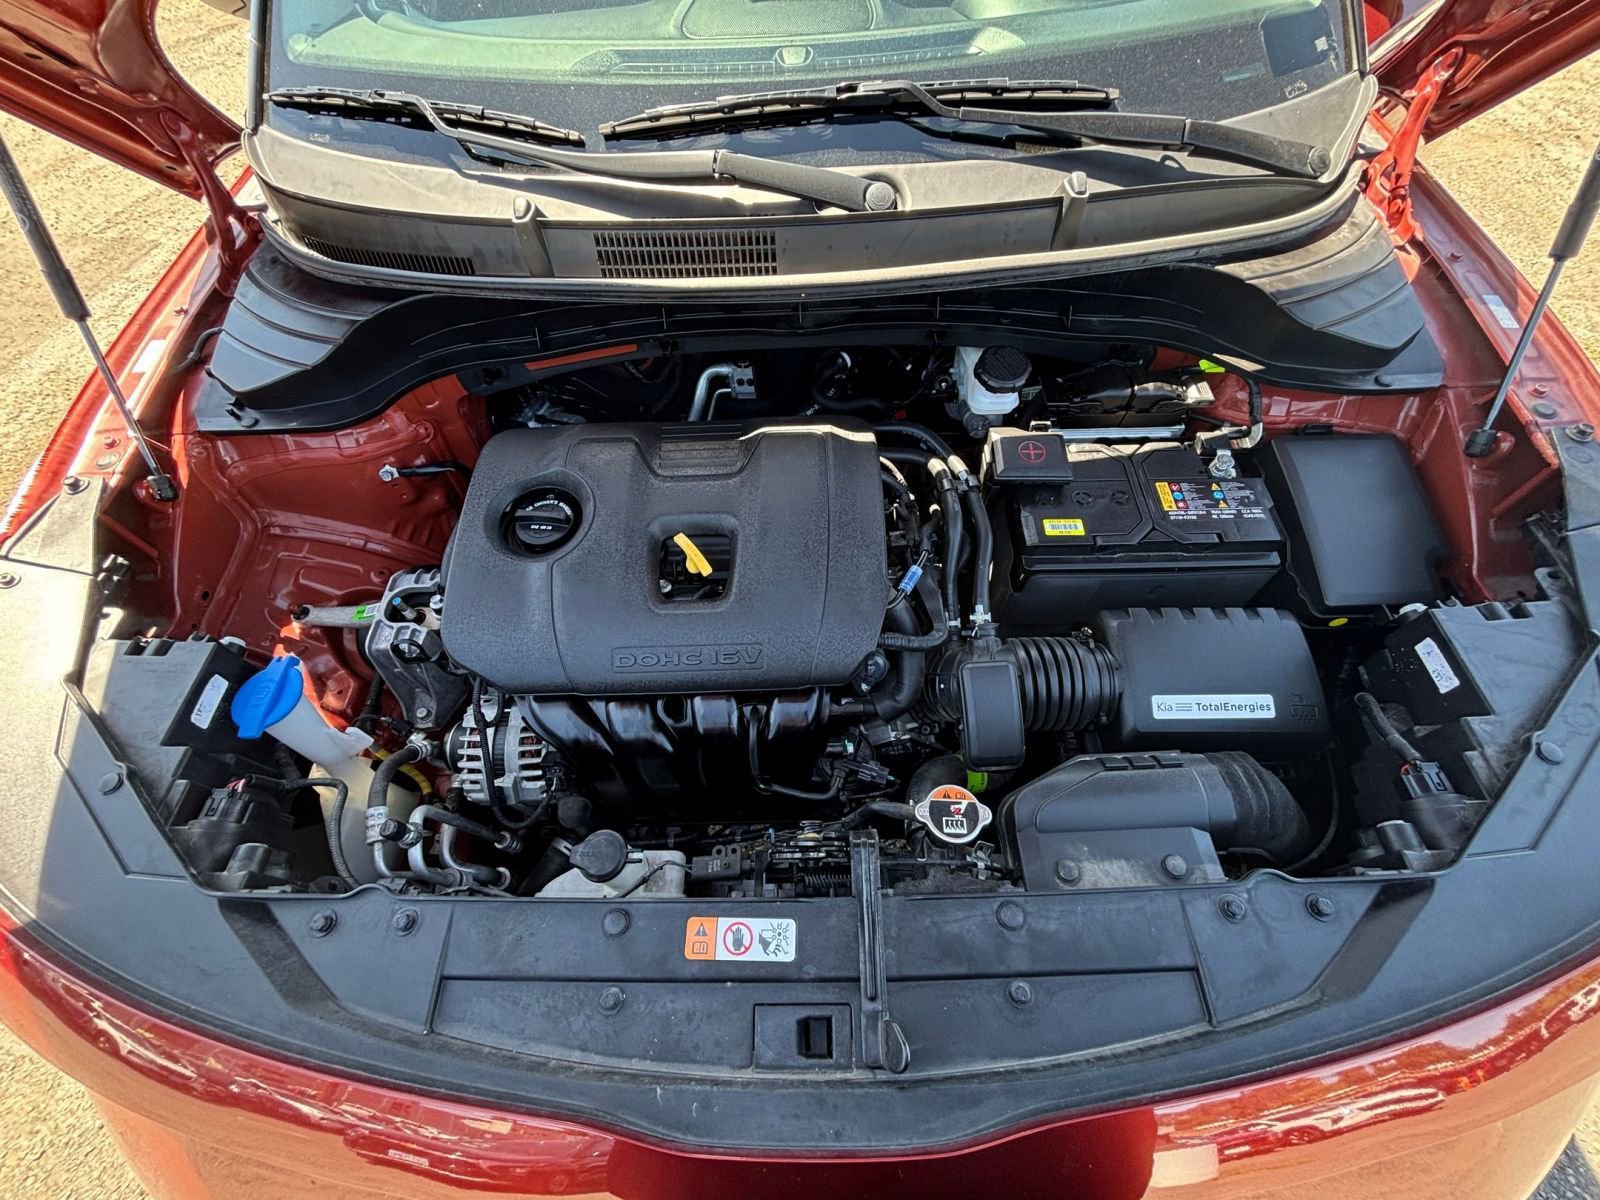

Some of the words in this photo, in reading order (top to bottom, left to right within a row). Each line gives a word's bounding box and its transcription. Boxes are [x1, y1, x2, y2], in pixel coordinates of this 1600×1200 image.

[614, 651, 702, 668] DOHC
[711, 649, 762, 665] 16V
[1157, 702, 1173, 712] Kia
[1195, 701, 1271, 713] TotalEnergies
